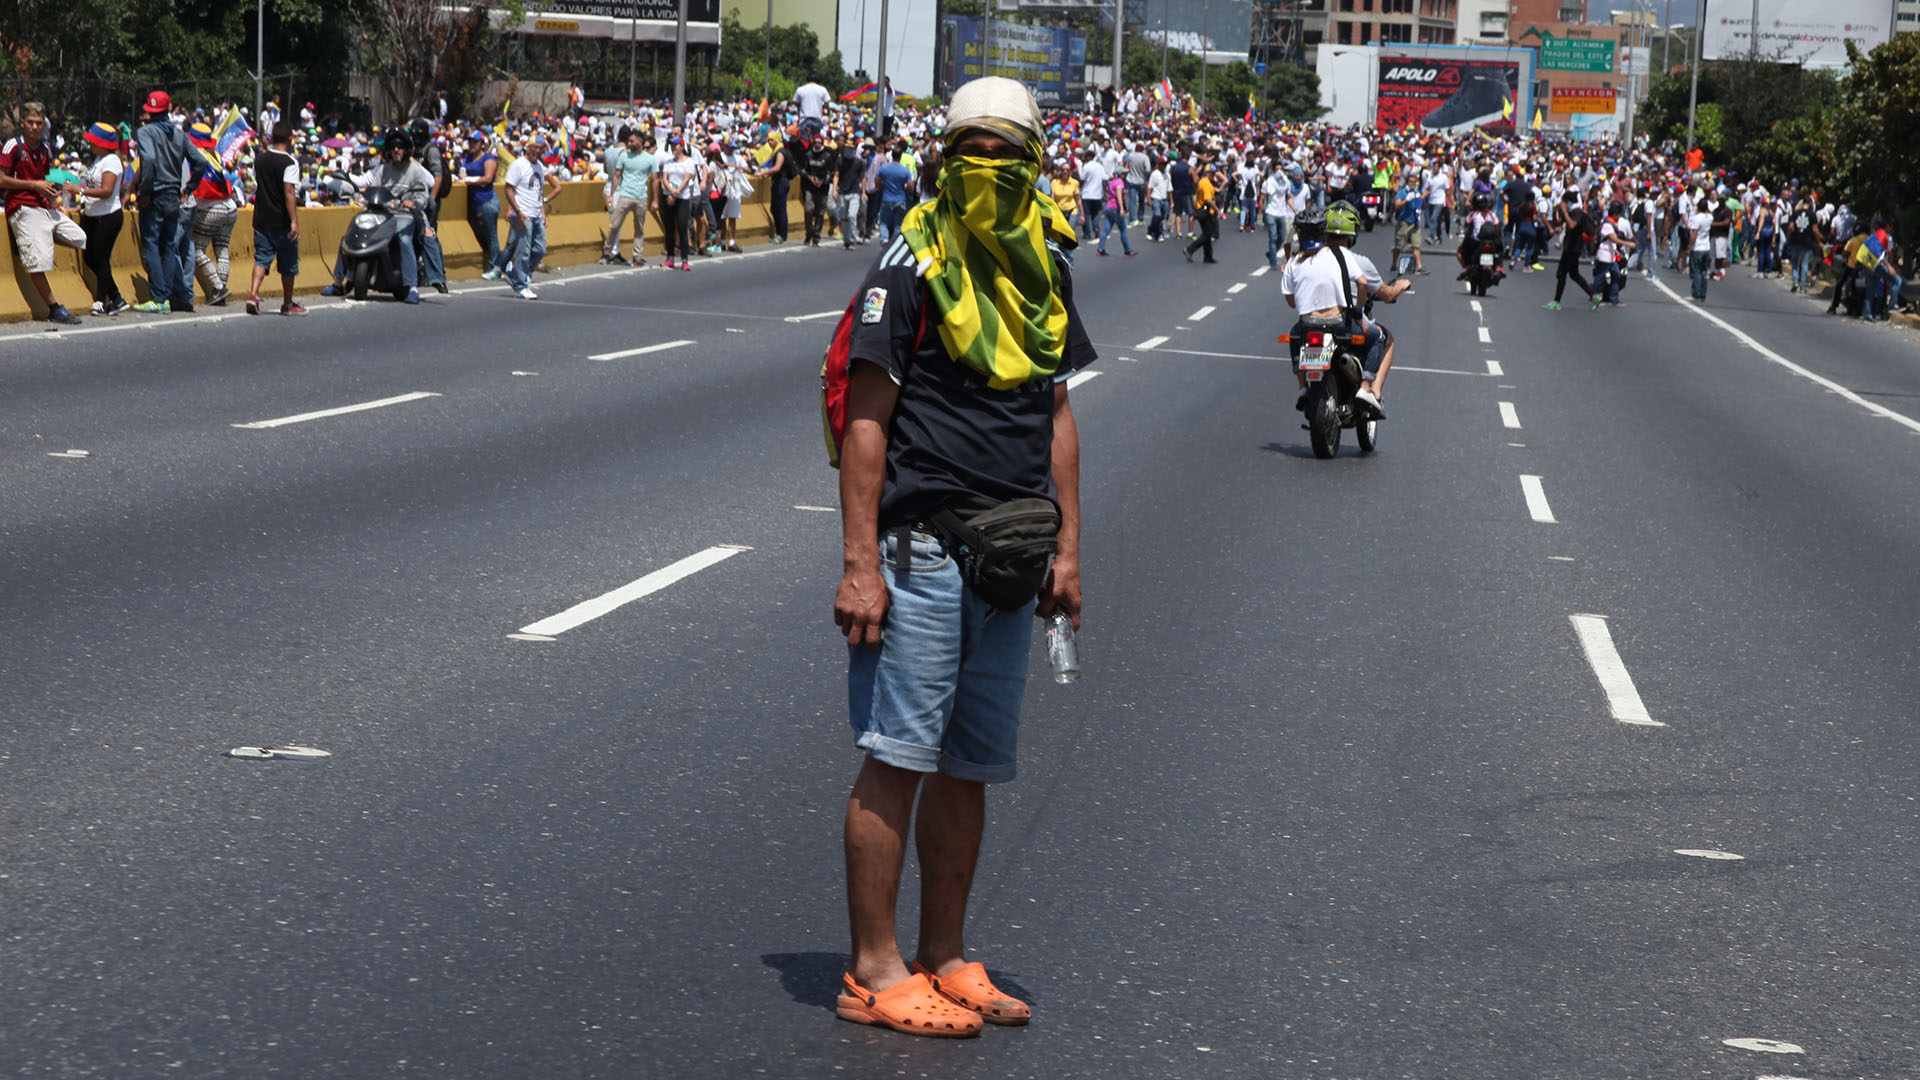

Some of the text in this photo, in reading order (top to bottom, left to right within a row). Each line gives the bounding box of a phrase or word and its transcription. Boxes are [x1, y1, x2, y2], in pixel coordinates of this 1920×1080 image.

[568, 5, 612, 16] VALORES
[614, 8, 640, 17] PARA
[642, 9, 654, 18] LA
[656, 10, 679, 19] VIDA
[1572, 41, 1604, 49] ALTAMIRA
[1543, 50, 1570, 58] PRADOS
[1588, 52, 1603, 60] ESTE
[1542, 60, 1590, 69] LAS MERCEDES
[1385, 67, 1437, 81] APOLO
